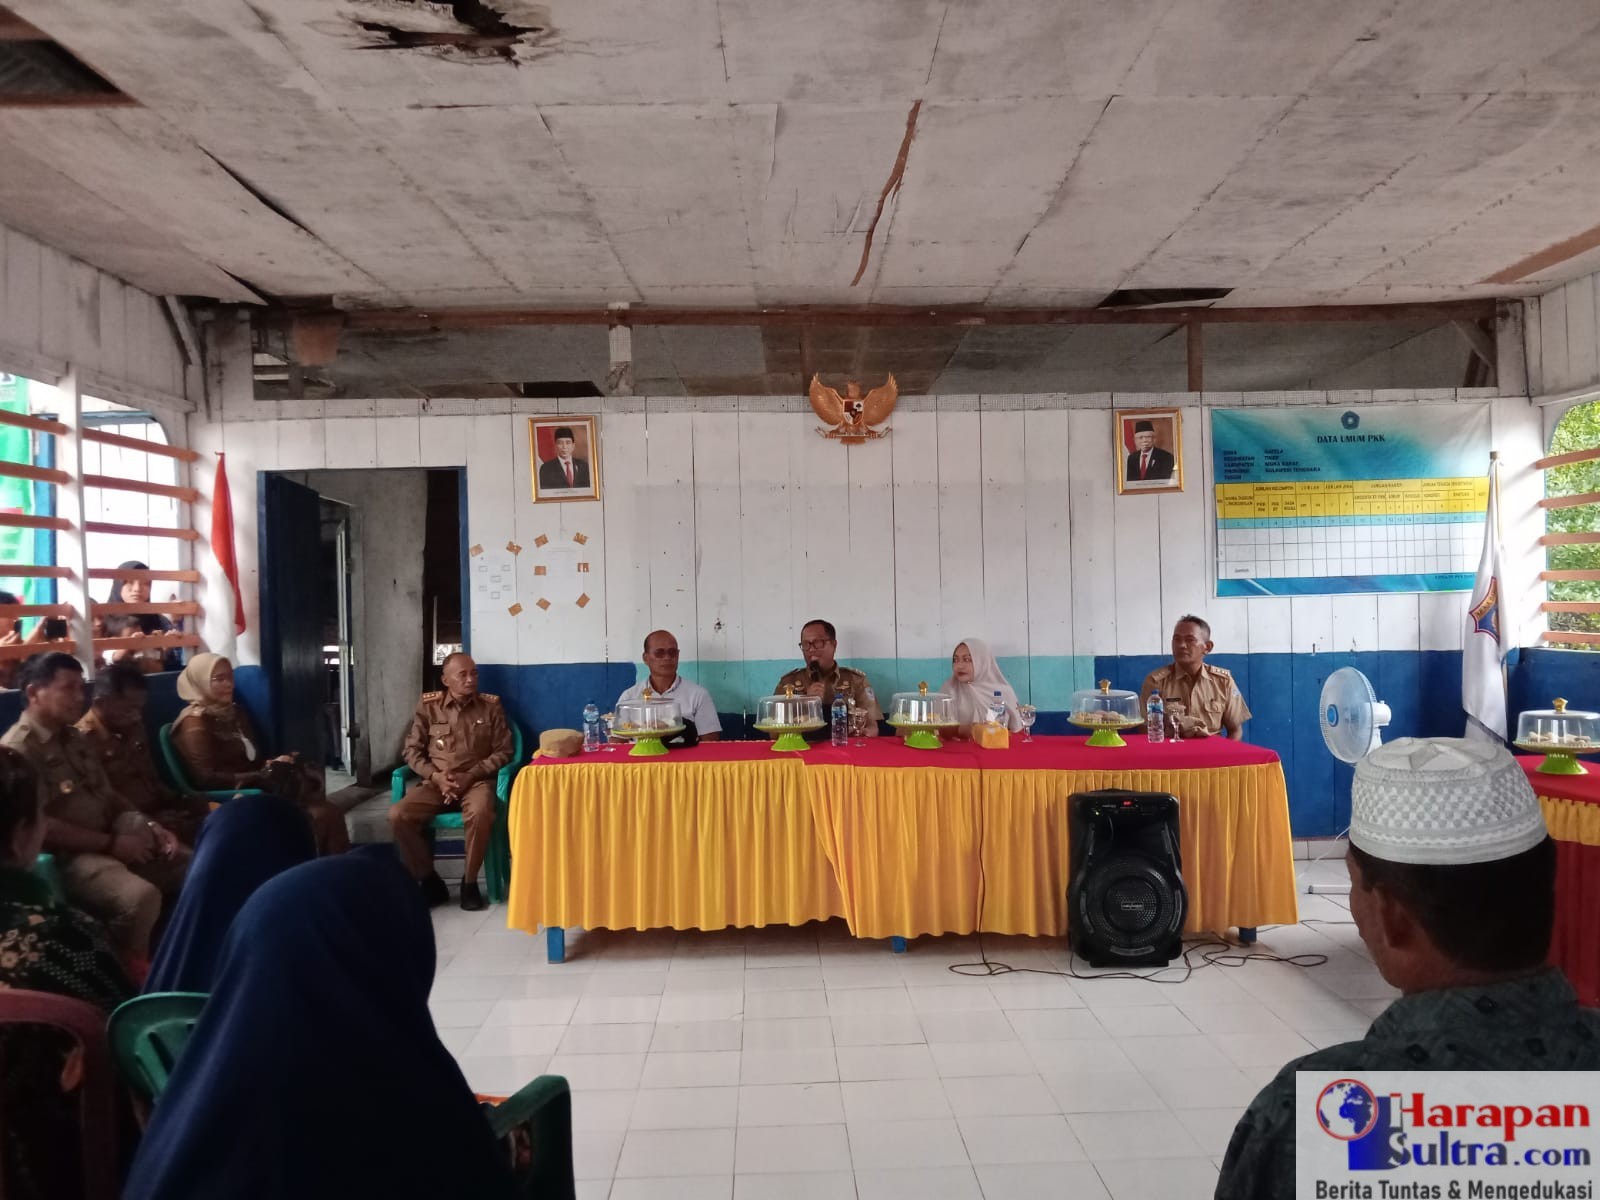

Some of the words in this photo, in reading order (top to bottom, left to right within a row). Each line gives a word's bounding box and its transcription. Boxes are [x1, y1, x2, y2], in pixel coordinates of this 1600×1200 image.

[1317, 435, 1338, 443] DATA
[1340, 435, 1366, 443] UMUM
[1368, 434, 1386, 442] PKK
